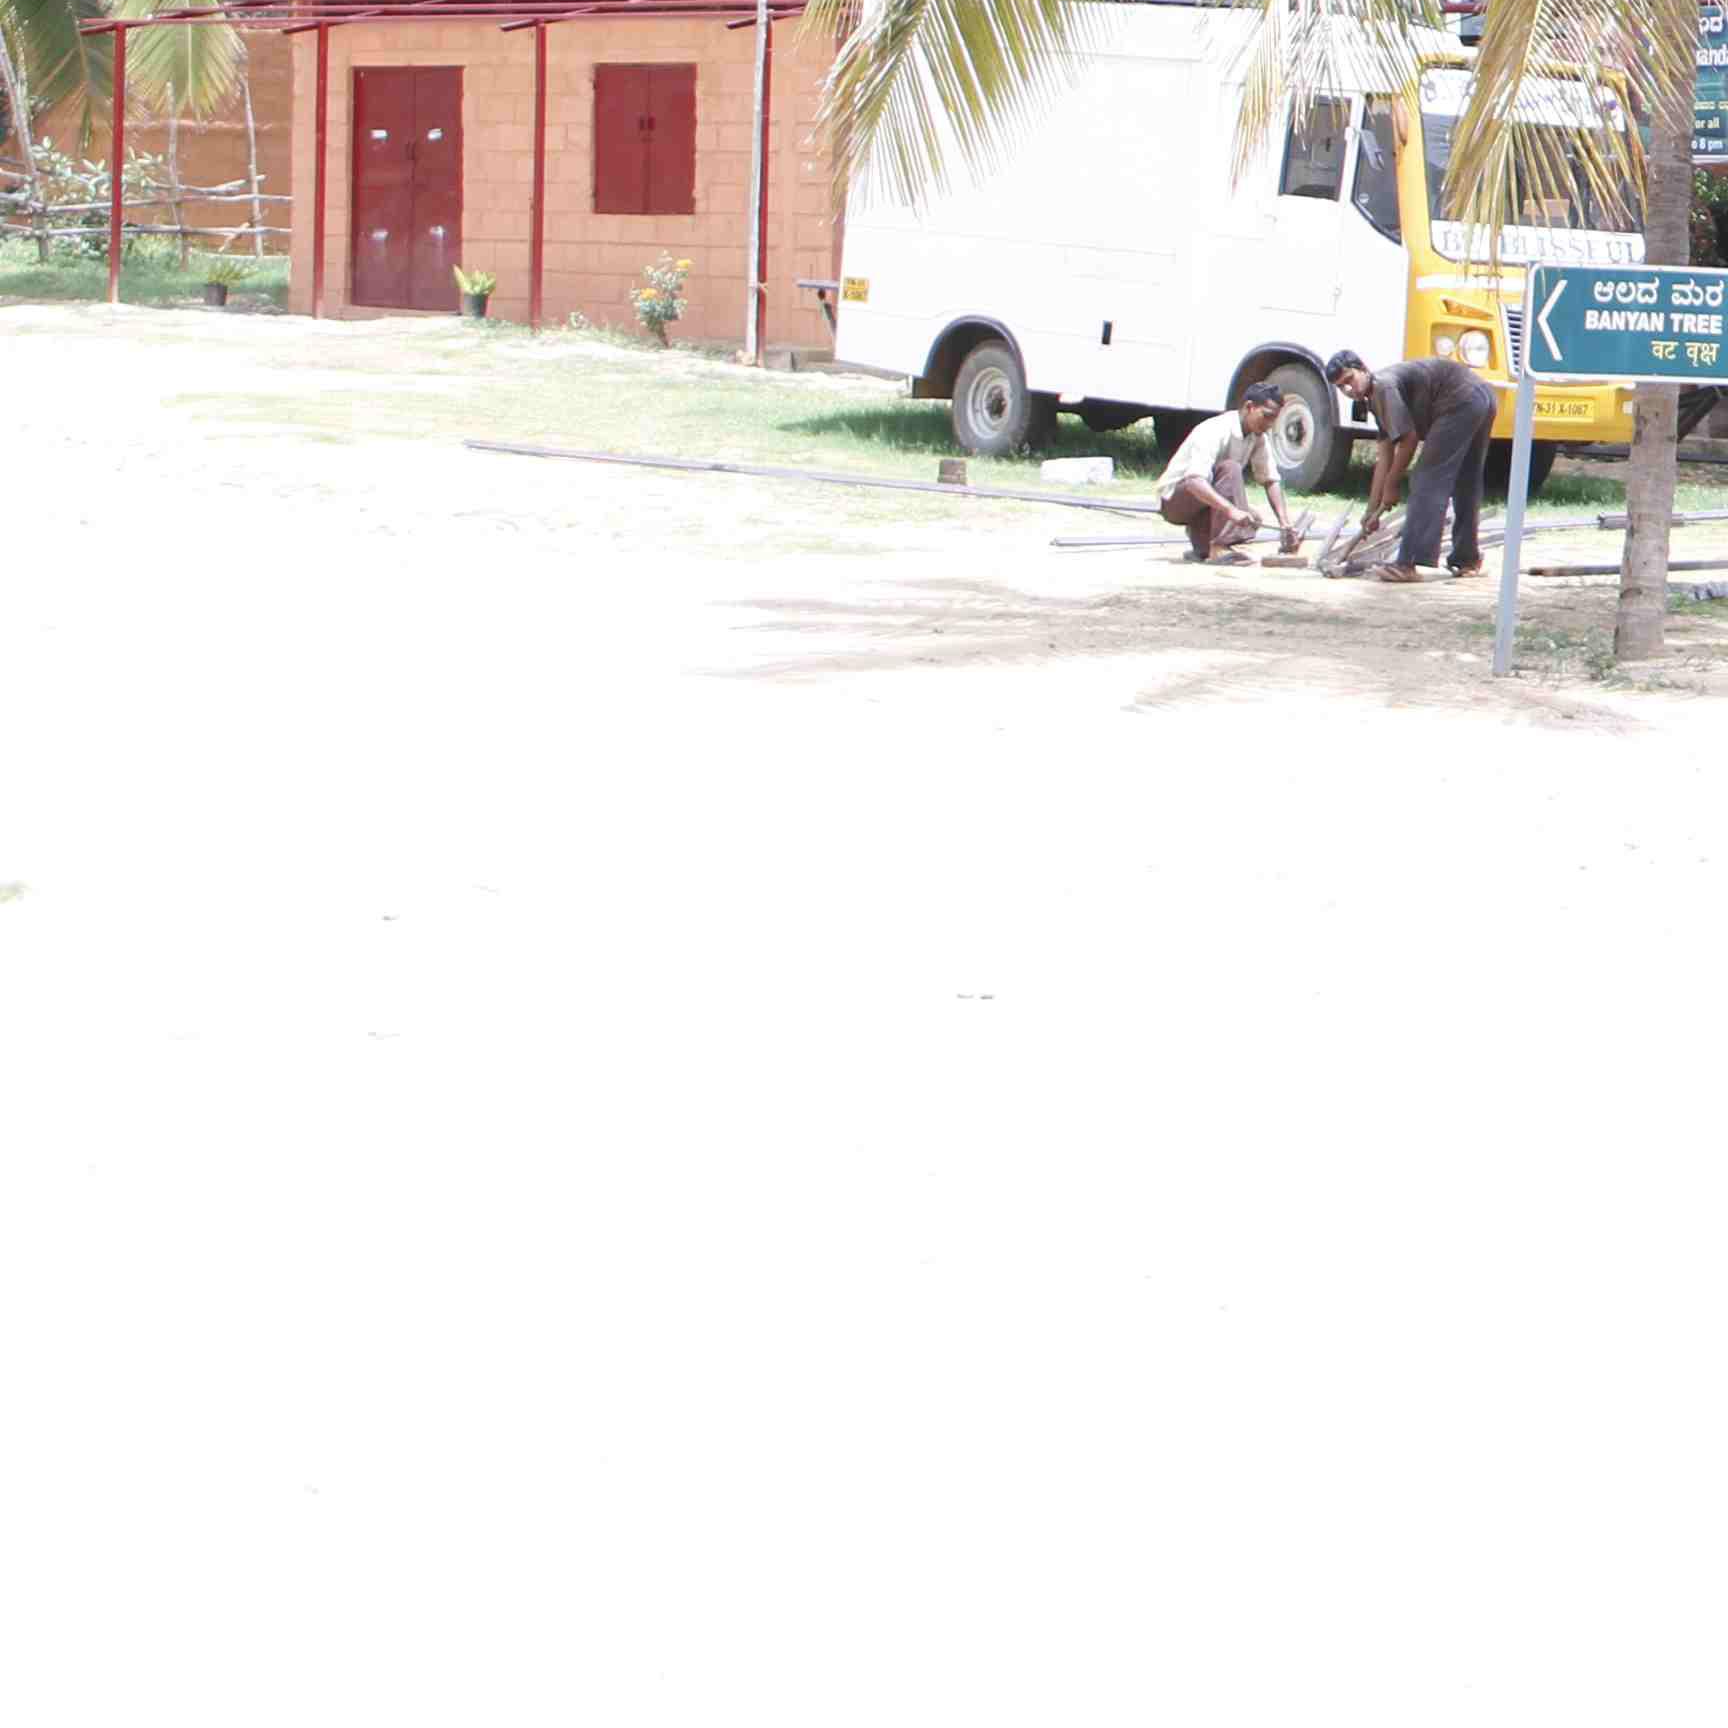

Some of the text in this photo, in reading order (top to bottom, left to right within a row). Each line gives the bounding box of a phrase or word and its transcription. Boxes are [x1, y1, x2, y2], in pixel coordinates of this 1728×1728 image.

[1585, 309, 1723, 335] BANYAN TREE
[1651, 339, 1679, 361] वट
